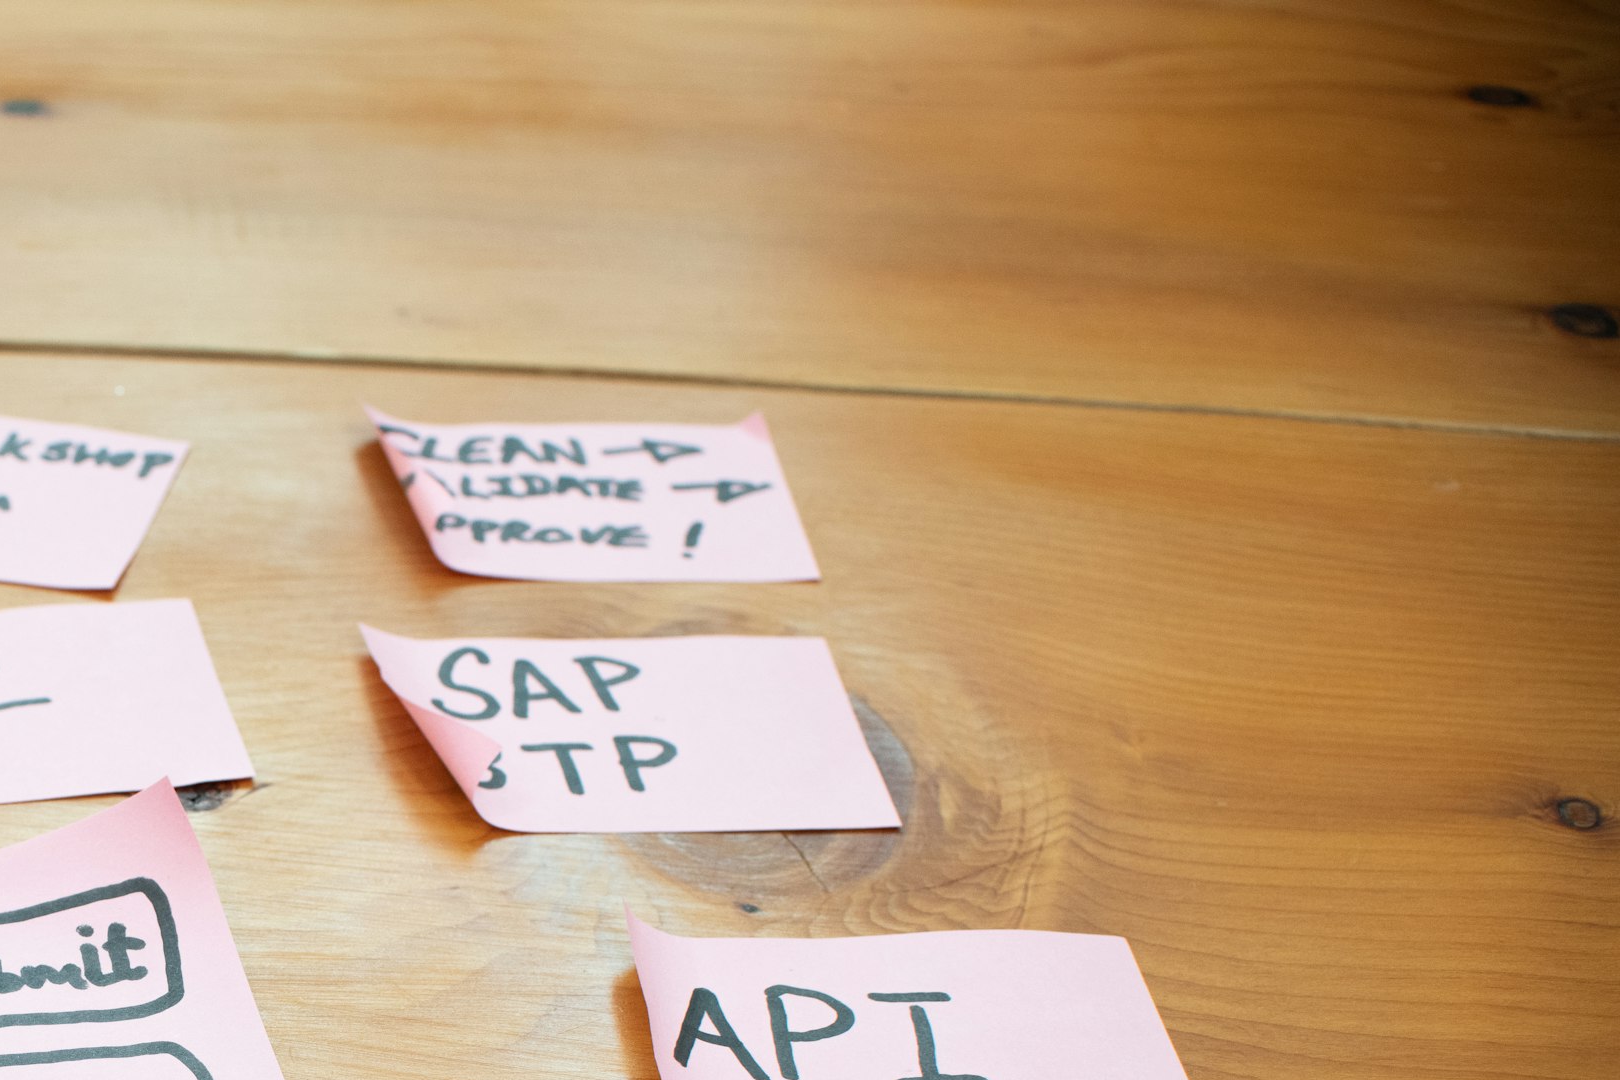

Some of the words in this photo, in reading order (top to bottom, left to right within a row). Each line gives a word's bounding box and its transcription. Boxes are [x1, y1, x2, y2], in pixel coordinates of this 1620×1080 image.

[378, 425, 588, 466] CLEAN
[401, 468, 643, 500] LIDATE
[434, 513, 648, 549] PPROVE
[430, 646, 641, 721] SAP
